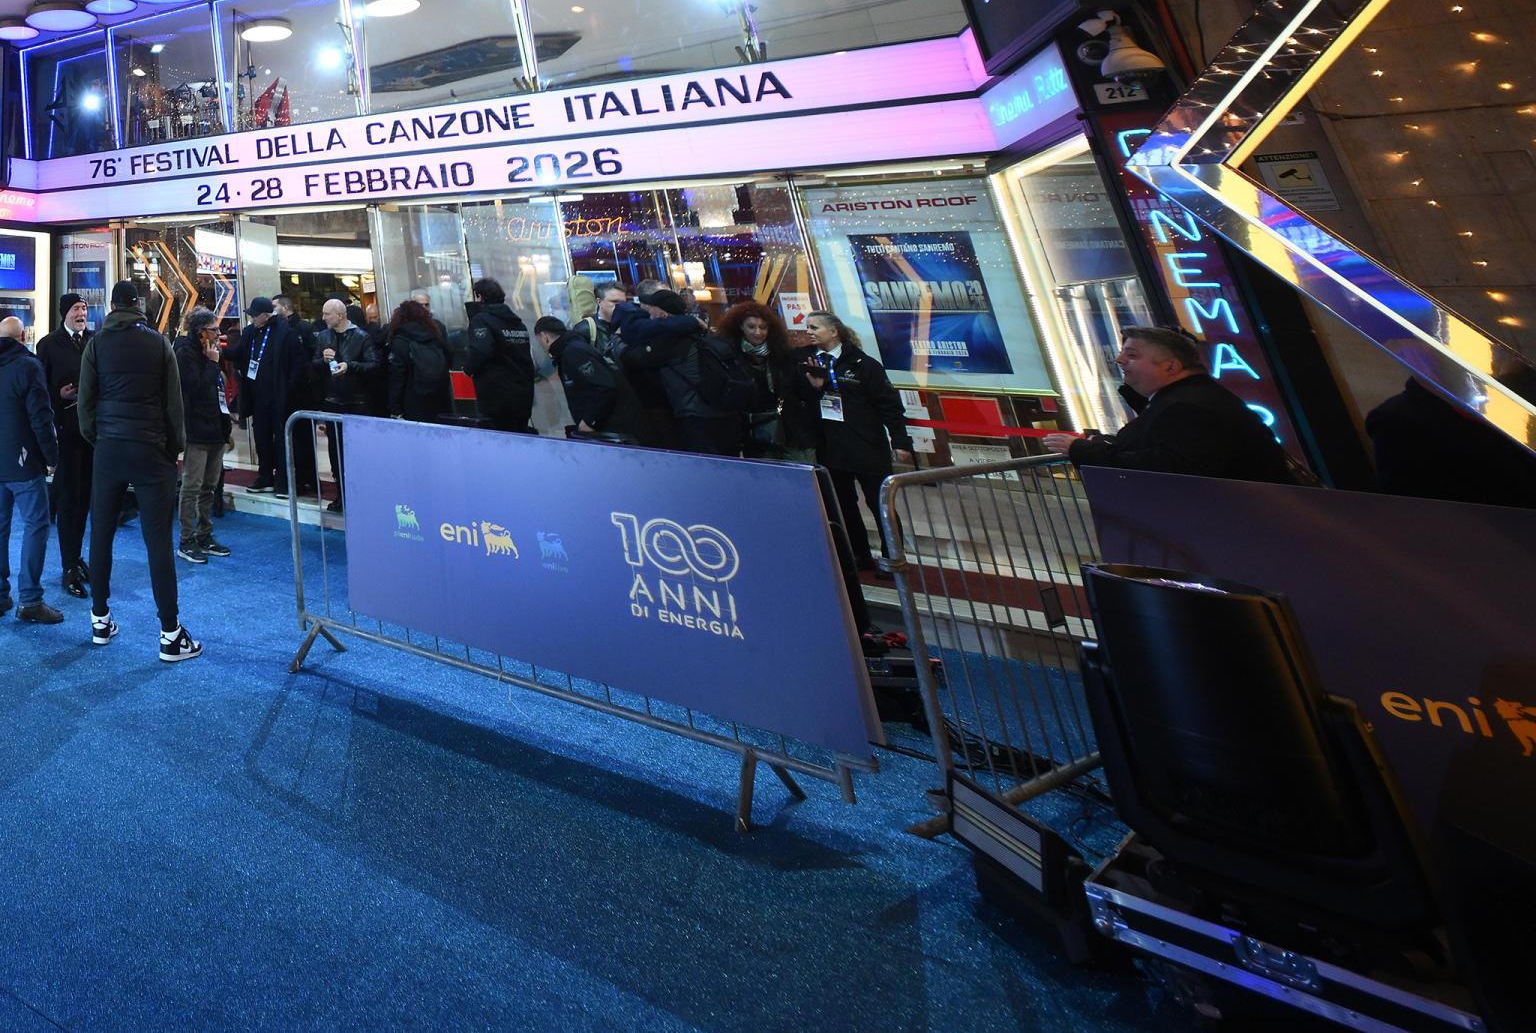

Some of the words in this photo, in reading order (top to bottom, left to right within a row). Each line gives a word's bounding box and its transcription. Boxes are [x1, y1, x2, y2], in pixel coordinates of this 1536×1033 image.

[1105, 86, 1137, 100] 212
[130, 143, 239, 176] FESTIVAL
[256, 128, 346, 160] DELLA
[366, 103, 535, 146] CANZONE
[563, 71, 794, 123] ITALIANA
[304, 161, 475, 197] FEBBRAIO
[506, 147, 623, 184] 2026
[821, 199, 913, 214] ARISTON
[916, 195, 978, 208] ROOF
[918, 242, 955, 252] SANREMO
[1118, 128, 1261, 380] CNEMA
[865, 280, 970, 310] SANREMO
[937, 341, 968, 350] ARISTON
[968, 445, 1009, 453] SOTTOPOSTA
[439, 520, 479, 548] eni
[610, 511, 740, 583] 100
[629, 573, 738, 623] ANNI
[630, 603, 650, 619] DI
[658, 608, 745, 641] ENERGIA
[1380, 691, 1494, 739] eni
